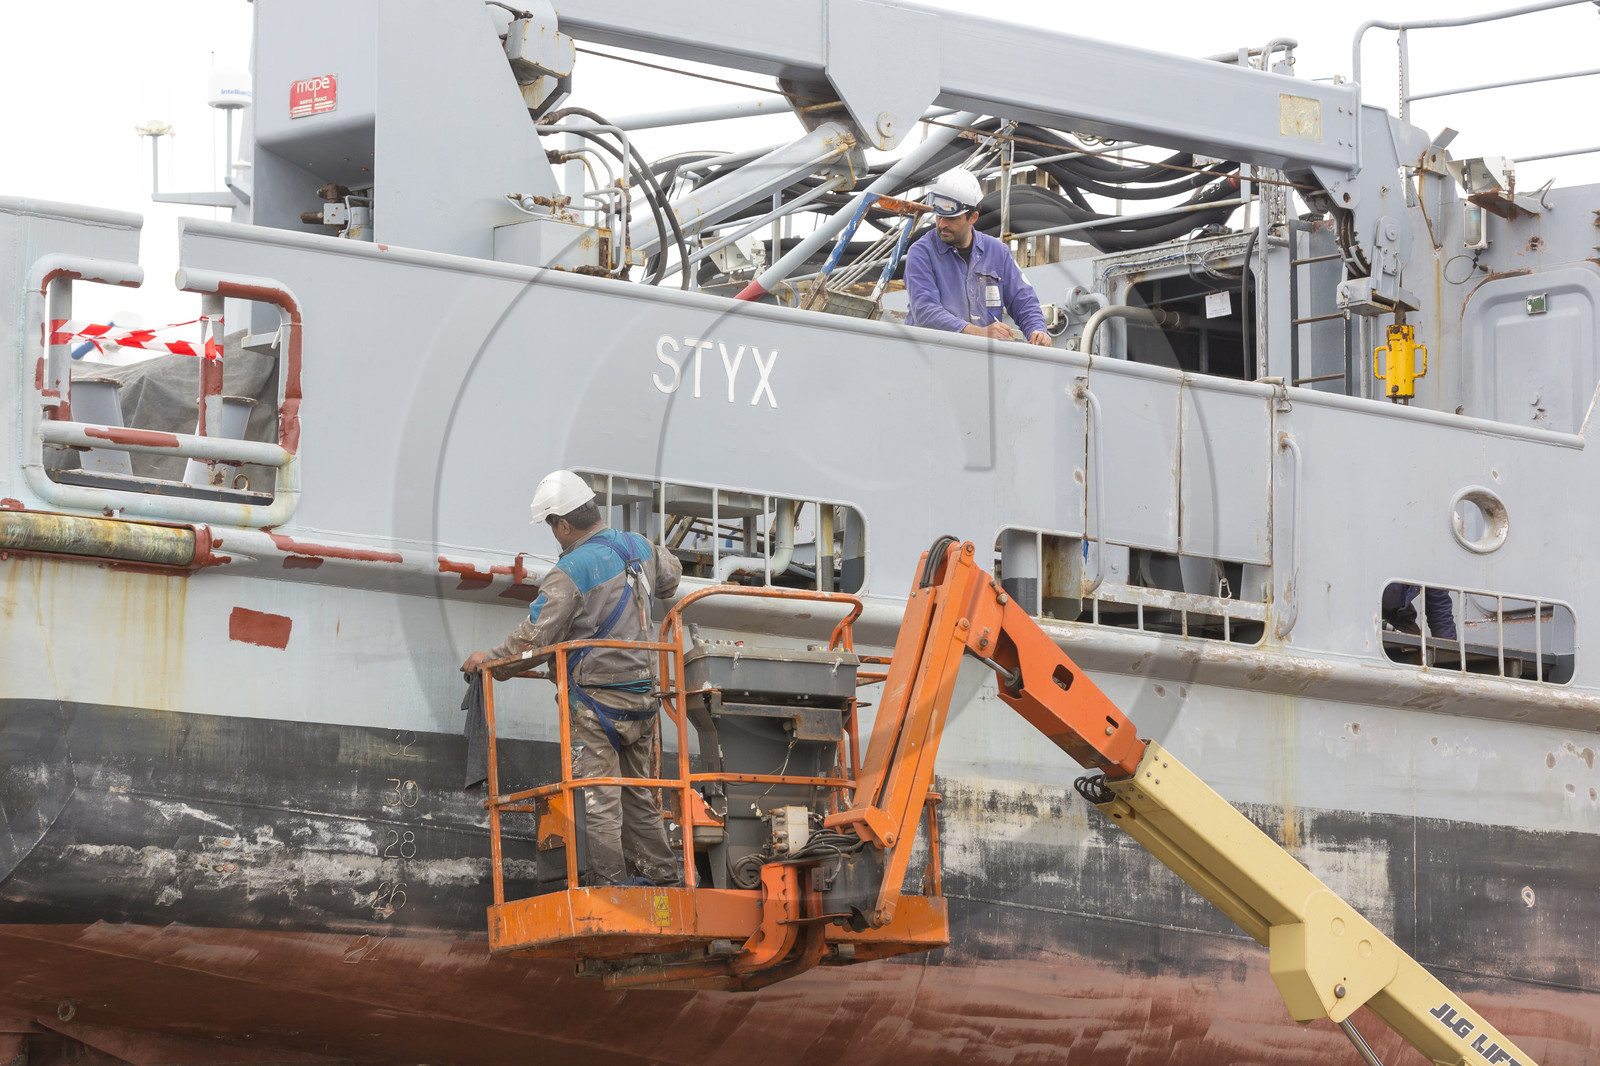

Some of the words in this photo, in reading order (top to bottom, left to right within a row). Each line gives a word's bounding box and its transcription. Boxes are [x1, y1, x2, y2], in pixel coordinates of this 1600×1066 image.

[297, 77, 330, 98] mape
[652, 334, 779, 409] STYX
[385, 727, 419, 758] 32
[384, 778, 419, 808] 30
[383, 829, 417, 859] 28
[371, 881, 408, 910] 26
[1428, 1002, 1475, 1040] JLG
